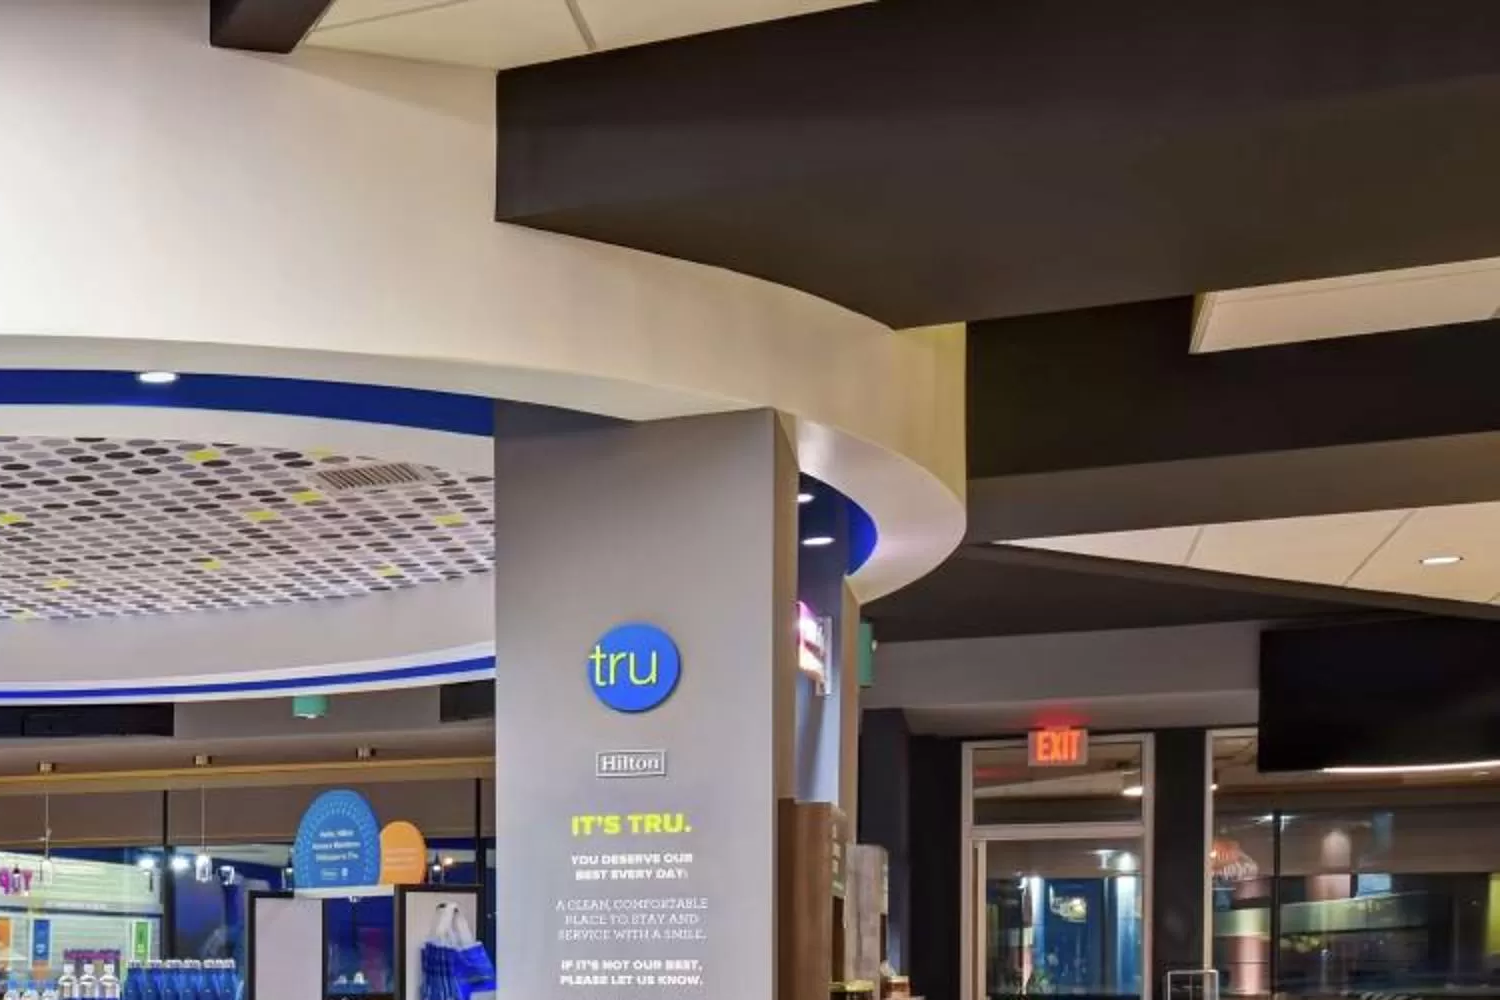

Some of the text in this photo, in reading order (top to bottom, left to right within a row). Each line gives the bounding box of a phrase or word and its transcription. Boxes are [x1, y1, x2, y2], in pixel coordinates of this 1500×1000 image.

[588, 645, 657, 686] tru
[1037, 731, 1080, 761] EXIT
[601, 755, 659, 771] Hilton
[571, 813, 693, 836] IT'S TRU.
[571, 853, 693, 865] YOU DESERVE OUR
[575, 869, 609, 881] BEST
[611, 868, 654, 880] EVERY
[613, 897, 709, 910] COMFORTABLE
[564, 913, 699, 925] PLACE TO STAY AND
[558, 929, 611, 941] SERVICE
[613, 929, 650, 940] WITH
[651, 929, 661, 940] A
[561, 959, 574, 970] IF
[575, 959, 599, 970] IT'S
[602, 959, 631, 970] NOT
[632, 959, 662, 970] OUR
[560, 975, 609, 985] PLEASE
[611, 975, 633, 985] LET
[636, 975, 655, 985] US
